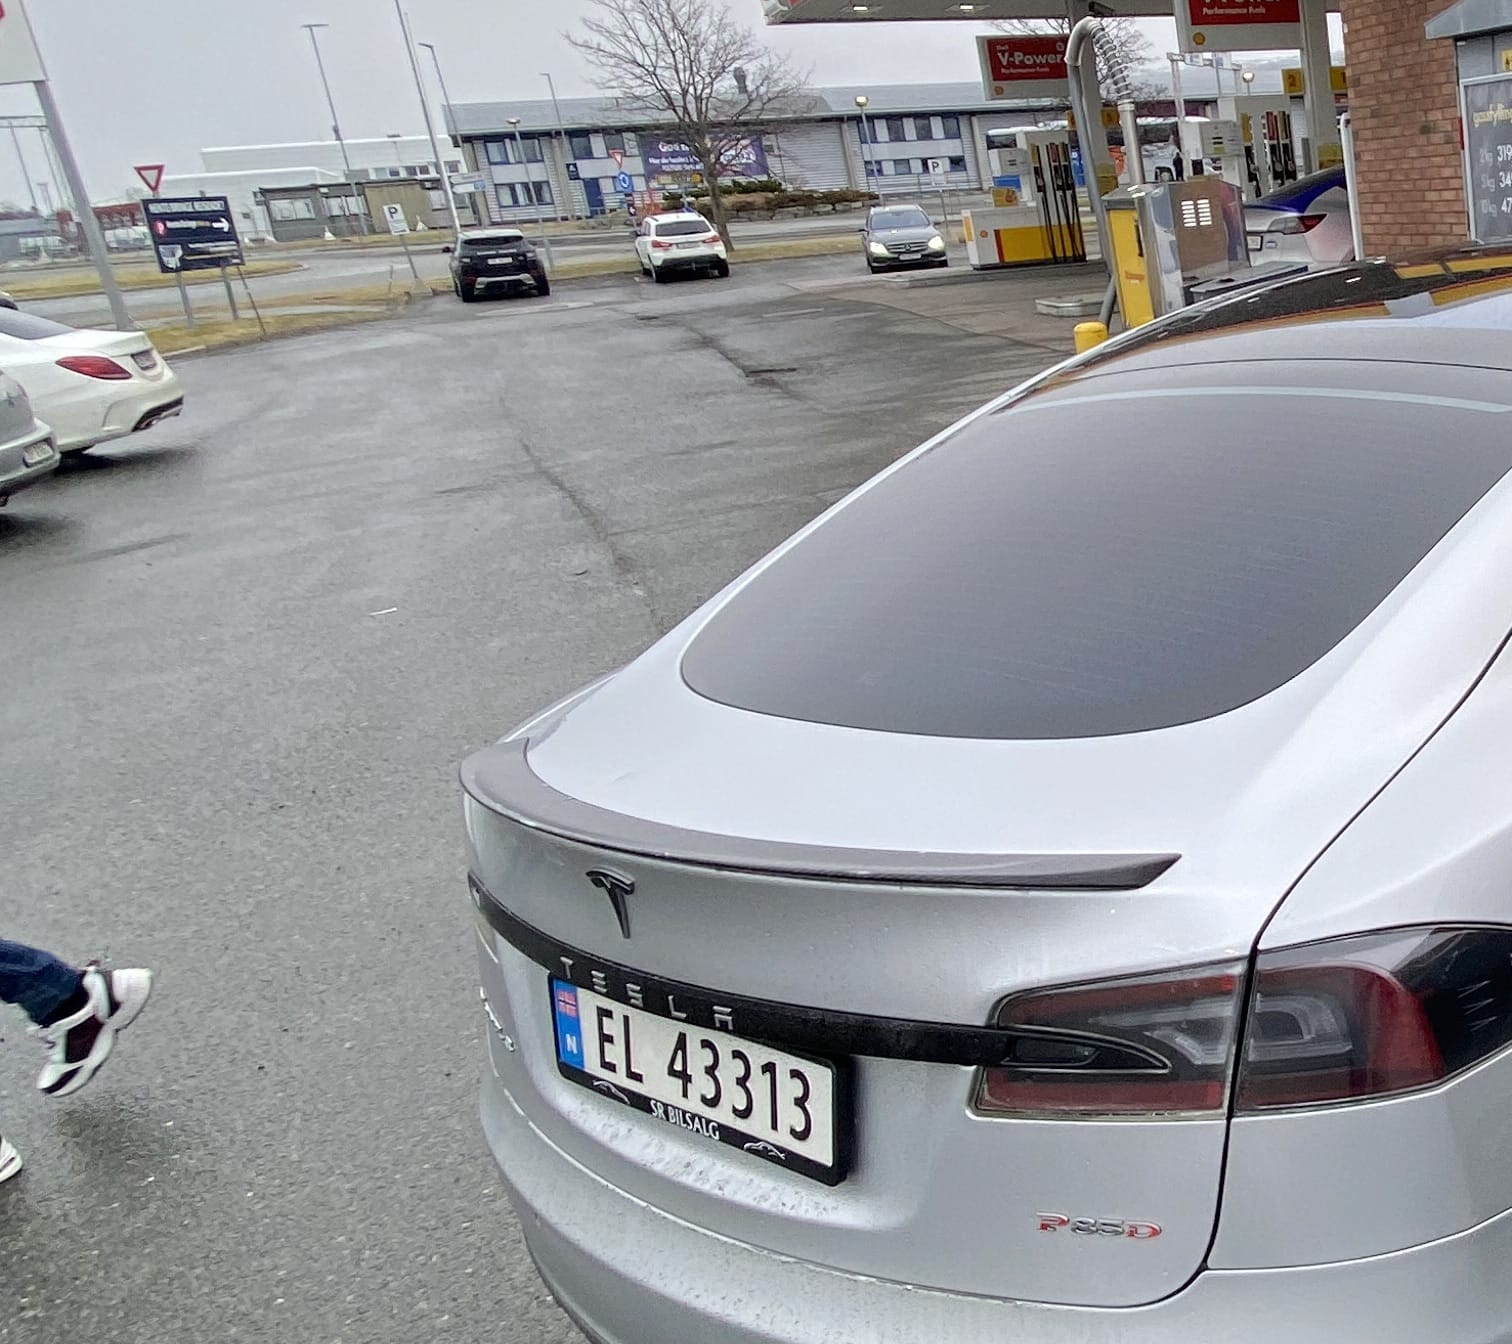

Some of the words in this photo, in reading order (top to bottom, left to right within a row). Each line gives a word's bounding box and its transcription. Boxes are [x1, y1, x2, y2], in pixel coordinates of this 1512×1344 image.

[997, 52, 1063, 66] V-Power
[932, 161, 940, 172] P
[388, 206, 398, 220] P
[559, 956, 735, 1031] TESLA
[566, 1033, 578, 1055] N
[596, 1005, 644, 1084] EL
[667, 1031, 812, 1142] 43313
[650, 1100, 669, 1121] SR
[669, 1105, 721, 1142] BILSALG
[1036, 1210, 1162, 1239] P85D
